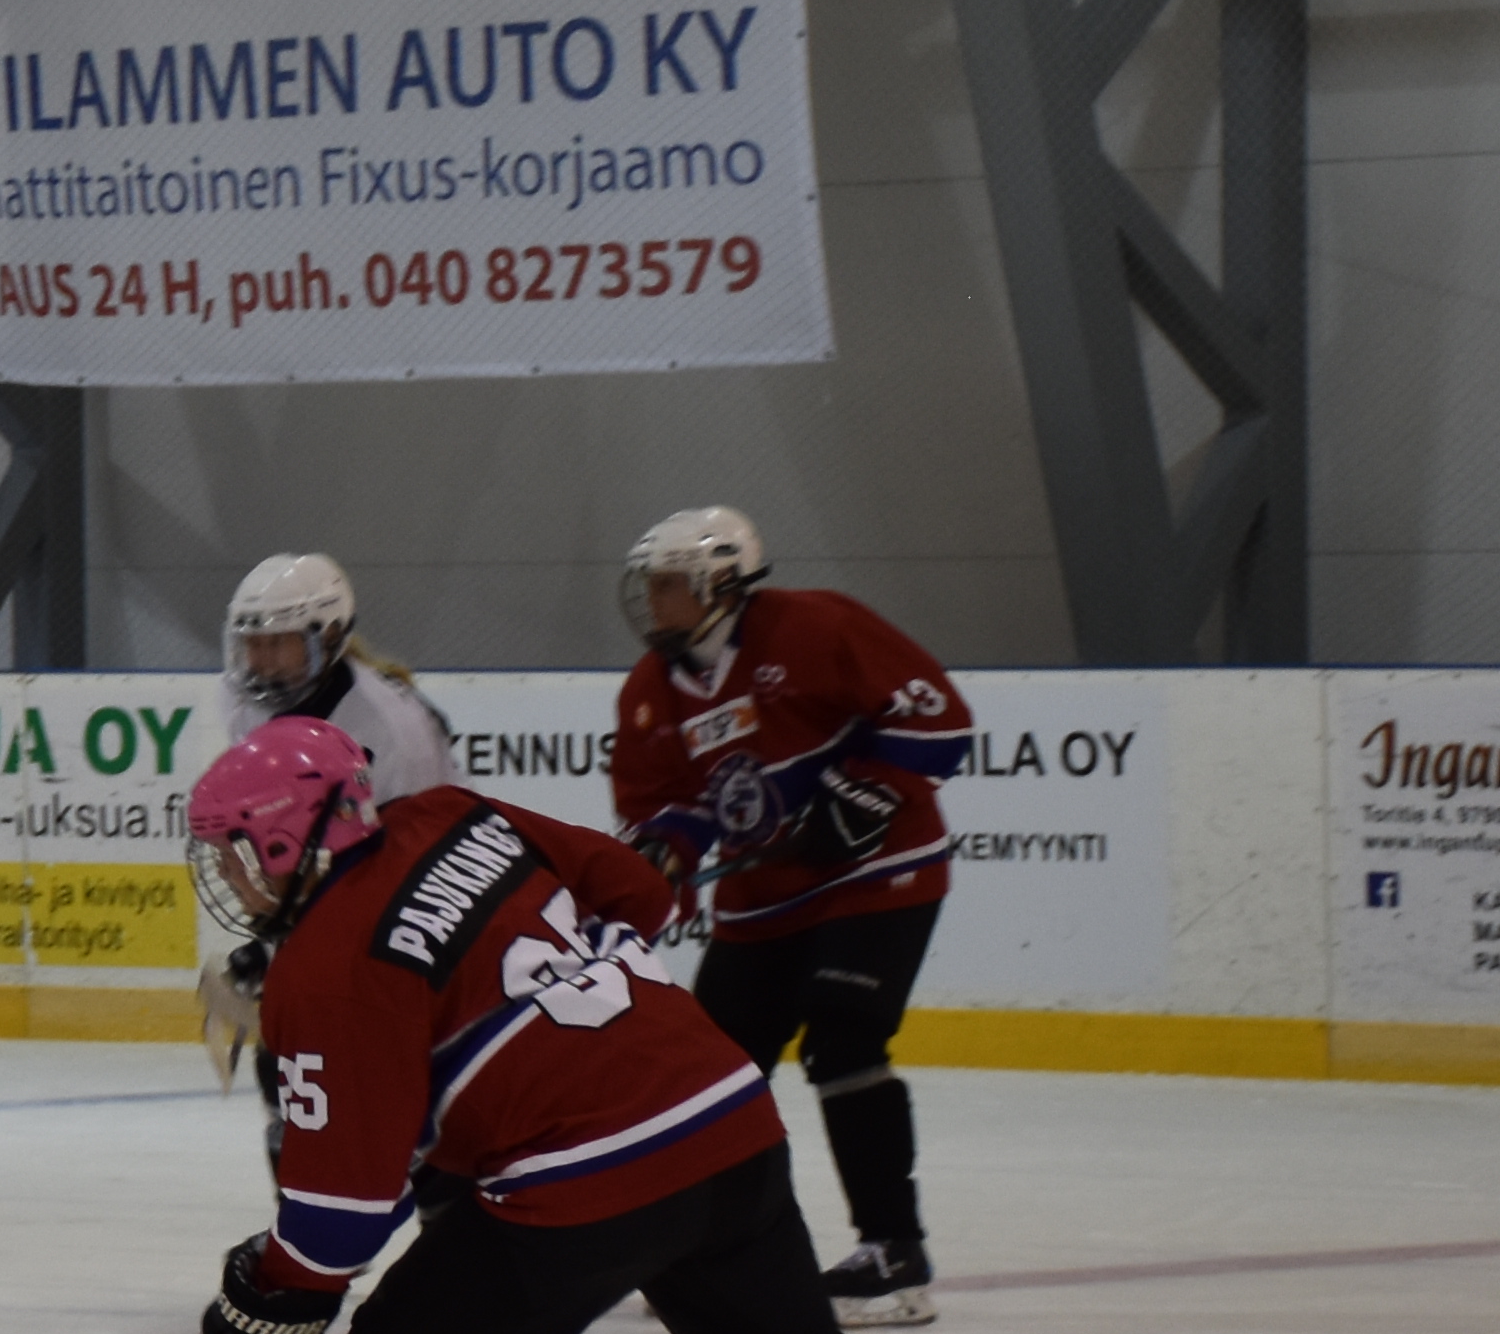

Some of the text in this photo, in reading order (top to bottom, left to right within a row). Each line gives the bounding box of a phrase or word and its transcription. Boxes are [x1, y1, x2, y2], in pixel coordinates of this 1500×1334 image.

[386, 17, 615, 114] AUTO
[643, 5, 757, 98] KY
[320, 133, 766, 213] Fixus-korjaamo
[89, 263, 151, 319] 24
[162, 258, 218, 326] H,
[226, 251, 351, 328] puh.
[364, 245, 471, 310] 040
[485, 234, 764, 304] 8273579
[84, 707, 193, 775] OY
[1062, 731, 1134, 776] OY
[50, 877, 74, 913] ja
